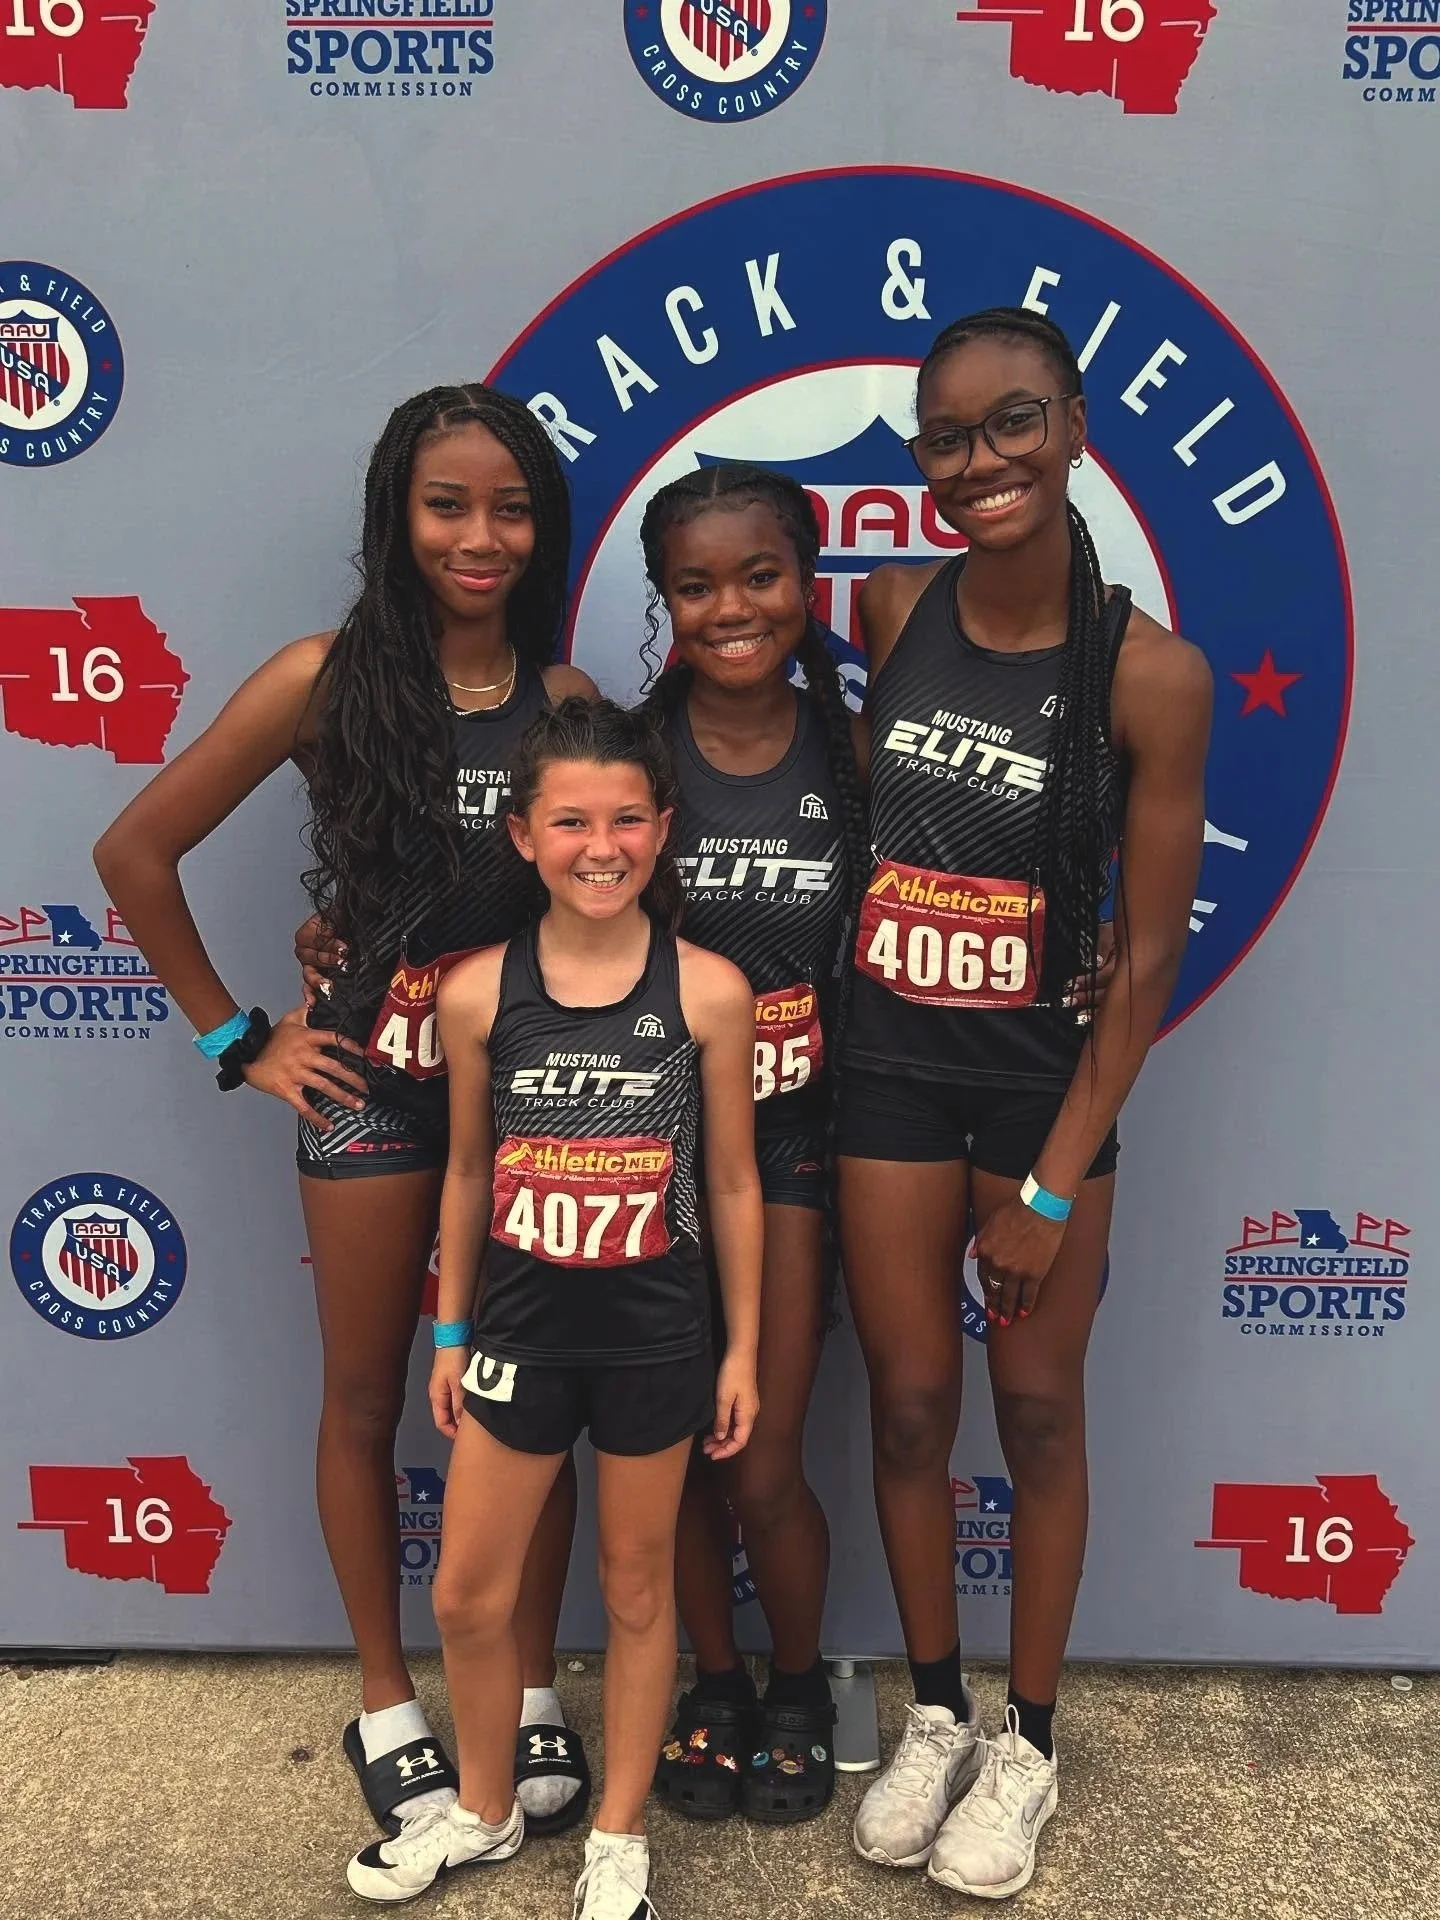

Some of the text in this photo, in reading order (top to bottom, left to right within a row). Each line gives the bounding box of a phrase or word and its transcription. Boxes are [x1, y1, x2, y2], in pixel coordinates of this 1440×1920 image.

[6, 0, 84, 37] 16
[286, 0, 493, 17] SPRINGFIELD
[1064, 0, 1145, 42] 16
[287, 29, 494, 75] SPORTS
[310, 82, 472, 97] COMMISSION
[643, 40, 808, 115] CROSS COUNTRY
[20, 274, 106, 333] & FIELD
[0, 324, 47, 337] AAU
[0, 350, 50, 396] USA
[526, 237, 1286, 525] RACK & FIELD
[26, 391, 108, 460] COUNTRY
[49, 646, 124, 702] 16
[931, 709, 1013, 745] MUSTANG
[884, 719, 1048, 793] ELITE
[457, 768, 511, 785] MUSTA
[896, 756, 1020, 801] TRACK CLUB
[460, 818, 496, 830] ACK
[698, 837, 789, 855] MUSTANG
[685, 890, 811, 905] RACK CLUB
[0, 955, 156, 975] PRINGFIEL
[867, 918, 1028, 991] 4069
[0, 985, 169, 1021] PORTS
[5, 1026, 150, 1039] COMMISSION
[377, 1012, 444, 1070] 40
[545, 1052, 621, 1068] MUSTANG
[753, 1034, 811, 1101] 85
[510, 1069, 664, 1097] ELITE
[524, 1097, 635, 1109] TRACK CLUB
[628, 1156, 662, 1170] NET
[22, 1183, 171, 1231] TRACK & FIELD
[504, 1186, 658, 1259] 4077
[75, 1223, 118, 1234] AAU
[75, 1242, 120, 1281] USA
[1224, 1255, 1409, 1277] SPRINGFIELD
[29, 1278, 173, 1334] CROSS COUNTRY
[1222, 1284, 1406, 1321] SPORTS
[1240, 1323, 1385, 1337] COMMISSION
[106, 1497, 174, 1544] 16
[1285, 1516, 1353, 1563] 16
